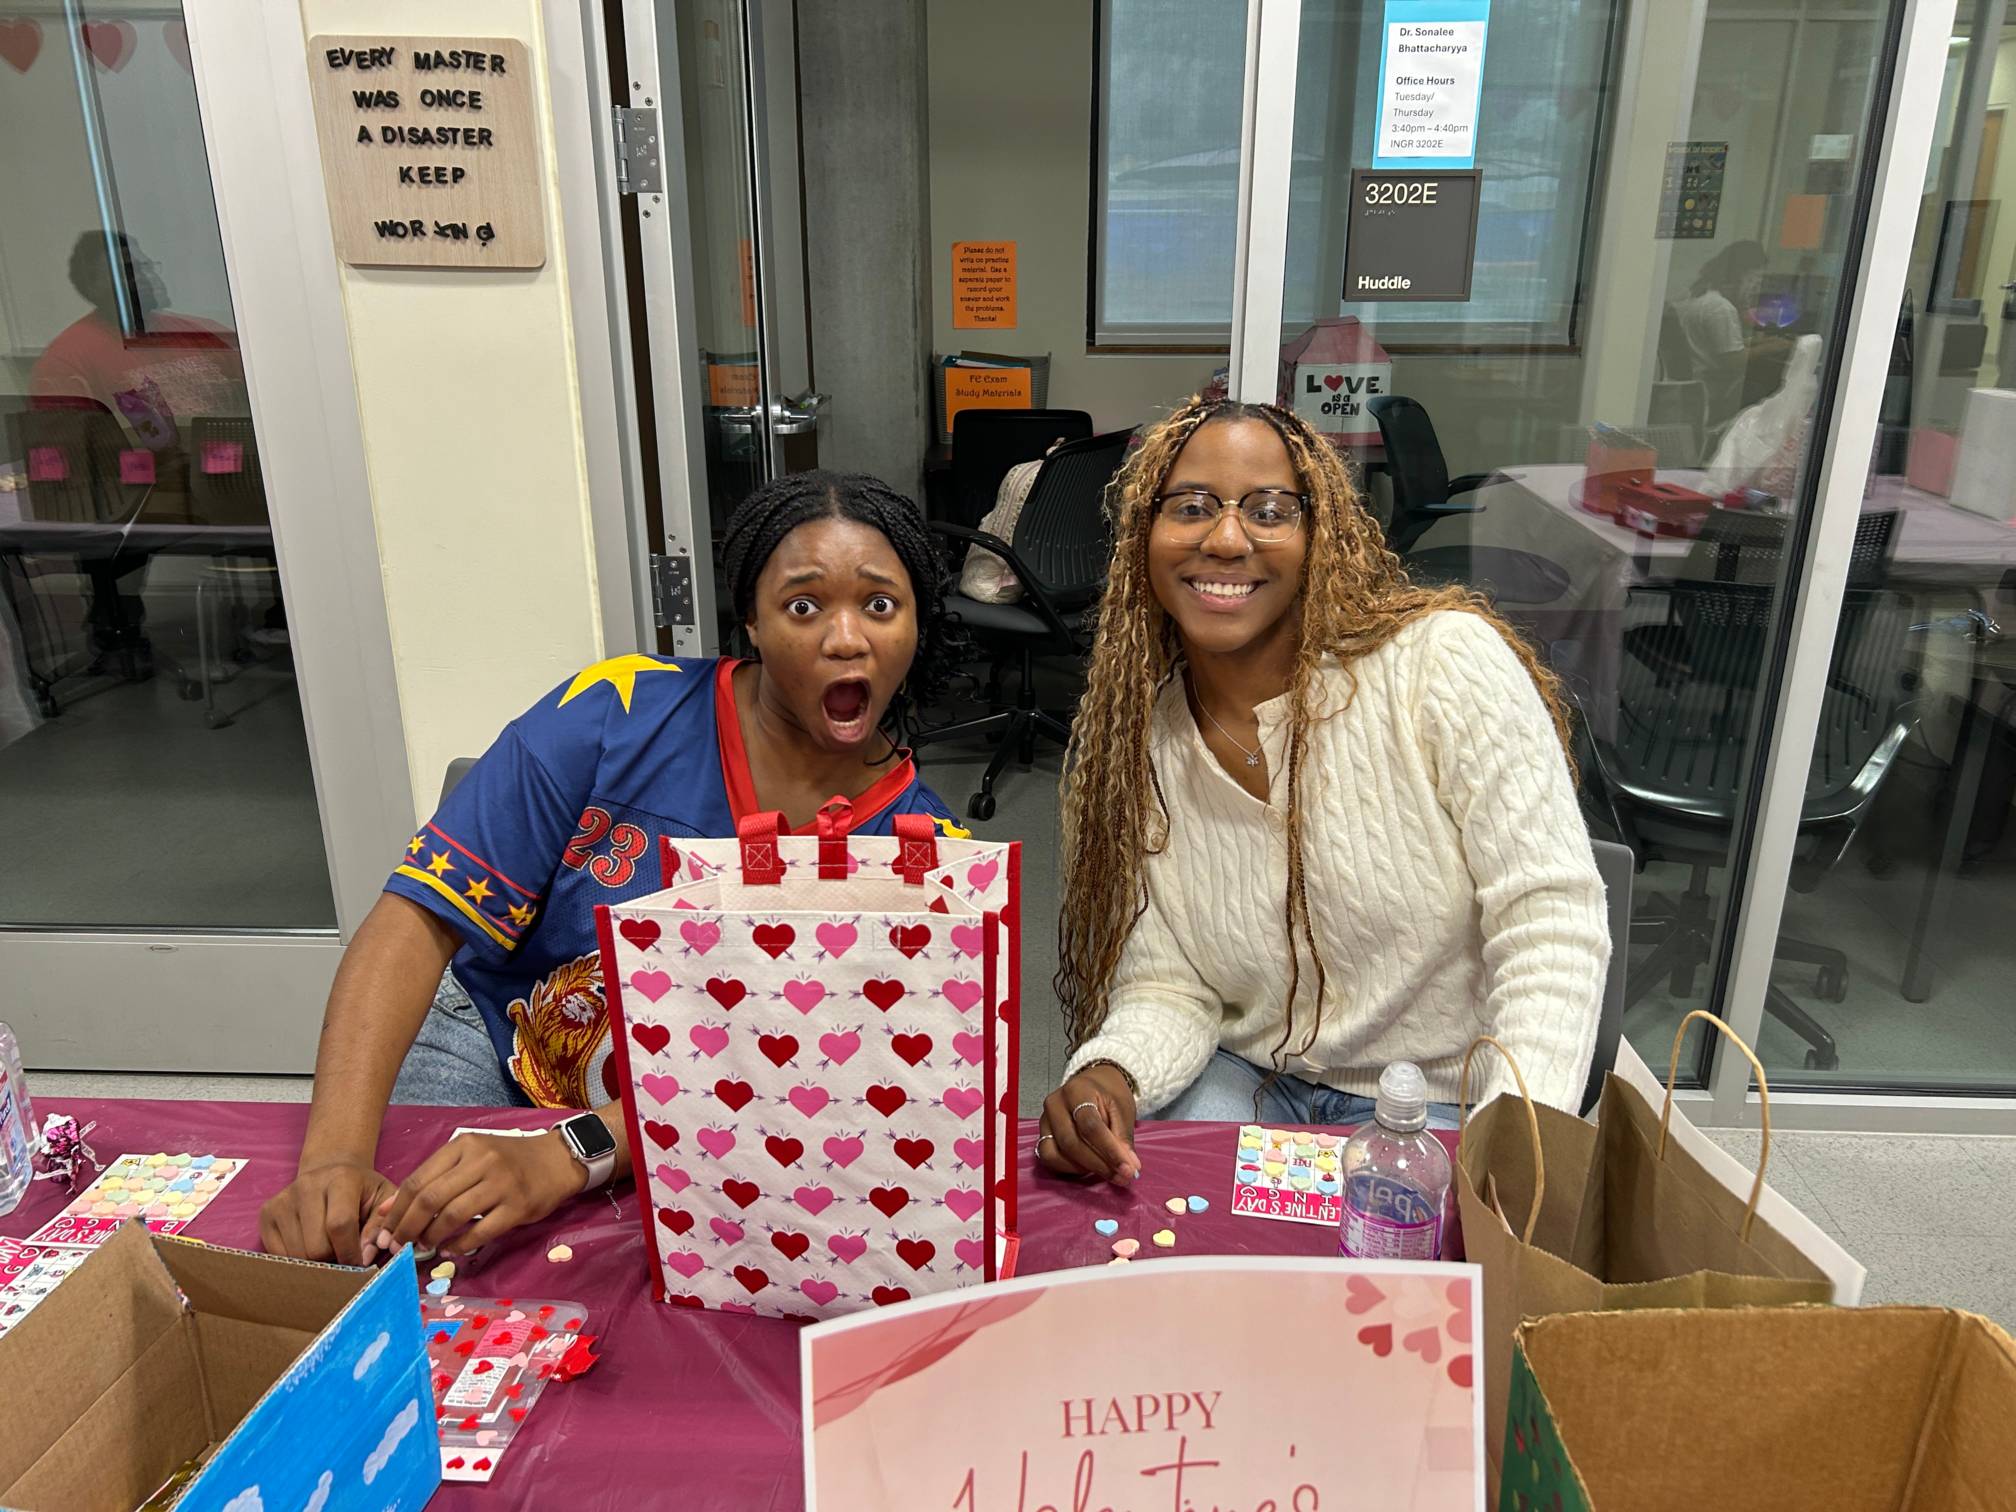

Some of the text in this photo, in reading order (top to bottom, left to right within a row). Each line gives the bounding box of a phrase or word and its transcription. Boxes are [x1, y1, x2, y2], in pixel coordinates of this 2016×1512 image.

[1399, 27, 1454, 37] Dr. Sonalee
[1398, 44, 1468, 54] Bhattacharyya
[326, 47, 506, 73] EVERY MASTER
[1396, 76, 1455, 86] Office Hours
[352, 89, 483, 109] WAS ONCE
[1395, 92, 1435, 103] Tuesday/
[1393, 108, 1434, 119] Thursday
[357, 125, 493, 146] A DISASTER
[1391, 124, 1425, 134] 3:40pm
[1434, 124, 1468, 134] 4:40pm
[1390, 139, 1444, 149] INGR 3202E
[399, 166, 466, 184] KEEP
[1365, 182, 1438, 205] 3202E
[1358, 275, 1411, 290] Huddle
[955, 388, 1022, 399] Study Materials
[1320, 401, 1361, 416] OPEN
[561, 806, 648, 888] 23
[1061, 1391, 1223, 1438] HAPPY
